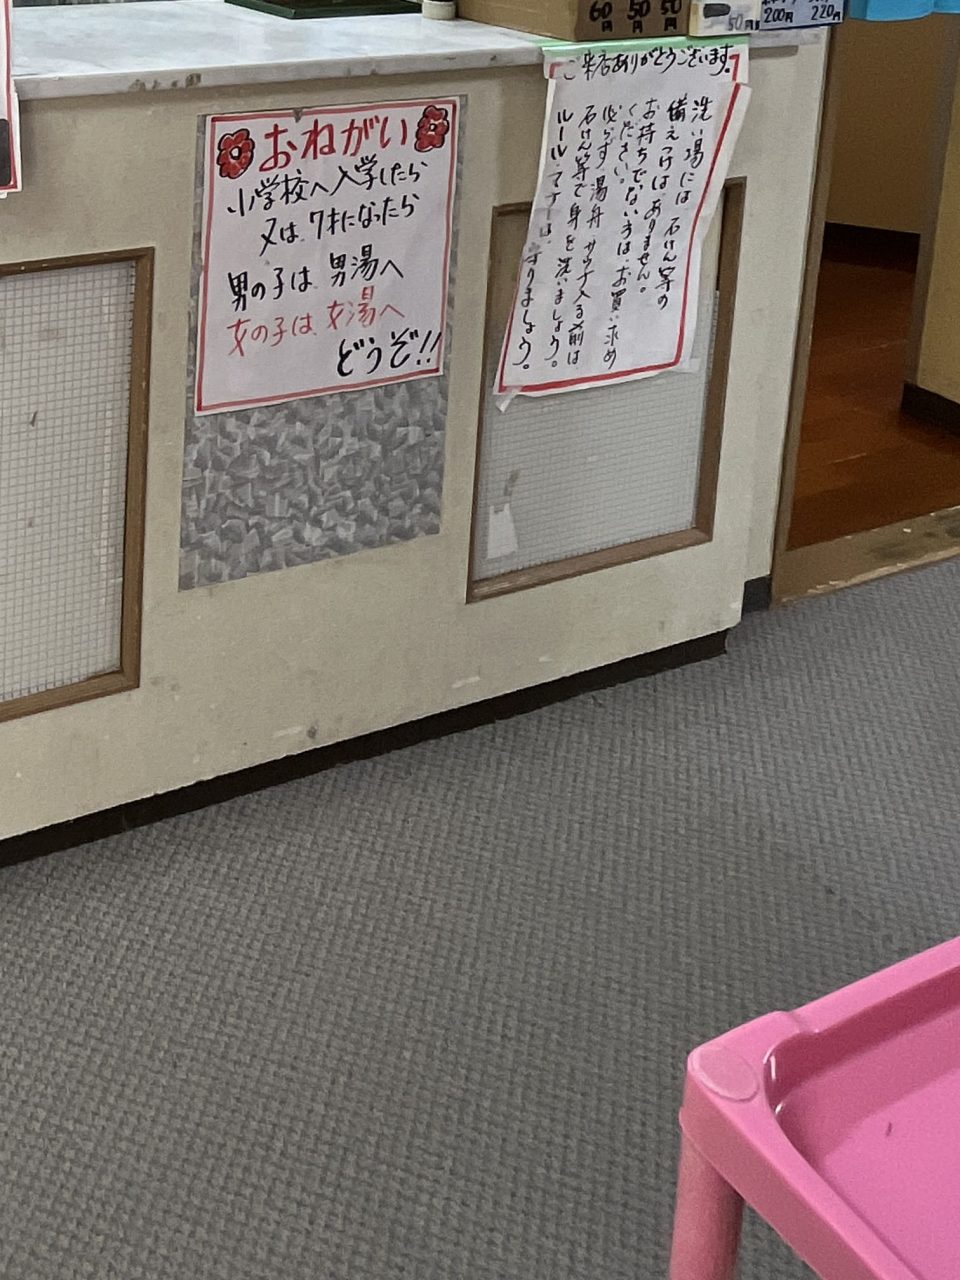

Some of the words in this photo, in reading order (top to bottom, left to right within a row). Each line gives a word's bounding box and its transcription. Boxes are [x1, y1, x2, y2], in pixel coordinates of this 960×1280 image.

[590, 0, 613, 20] 60
[602, 20, 613, 33] 円
[632, 19, 643, 33] 円
[664, 17, 678, 31] 円
[763, 7, 794, 24] 200円
[811, 4, 841, 21] 220円
[563, 45, 733, 82] ご来店ありがとうございます。
[259, 115, 408, 172] おねがい
[227, 153, 429, 217] 小学校へ入学したら
[544, 104, 596, 368] 石けん等で身を洗いましょう。
[337, 328, 442, 377] どうぞ!!
